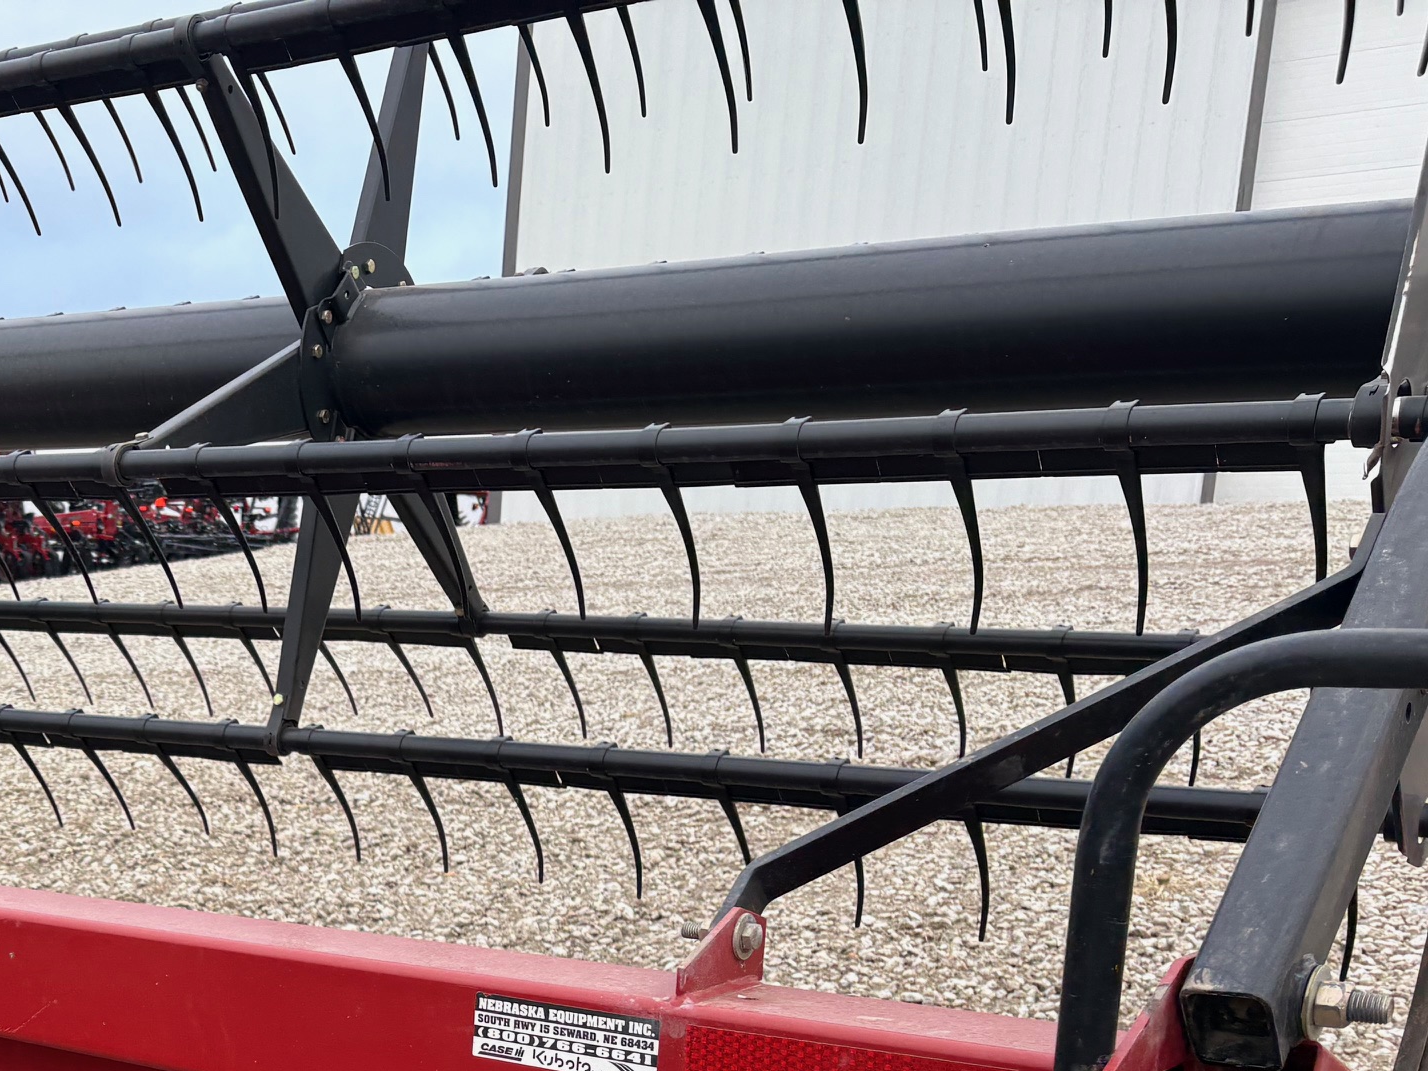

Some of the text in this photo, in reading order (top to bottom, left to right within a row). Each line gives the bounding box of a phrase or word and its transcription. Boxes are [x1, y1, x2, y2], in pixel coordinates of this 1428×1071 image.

[477, 1013, 511, 1028] SOUTH
[514, 1020, 537, 1032] HWY
[539, 1023, 551, 1034] 15
[603, 1034, 618, 1046] NE
[620, 1037, 655, 1051] 68434
[478, 997, 656, 1037] NEBRASKA EQUIPMENT INC.
[477, 1026, 653, 1066] (800)766-6641
[480, 1042, 514, 1056] CASE
